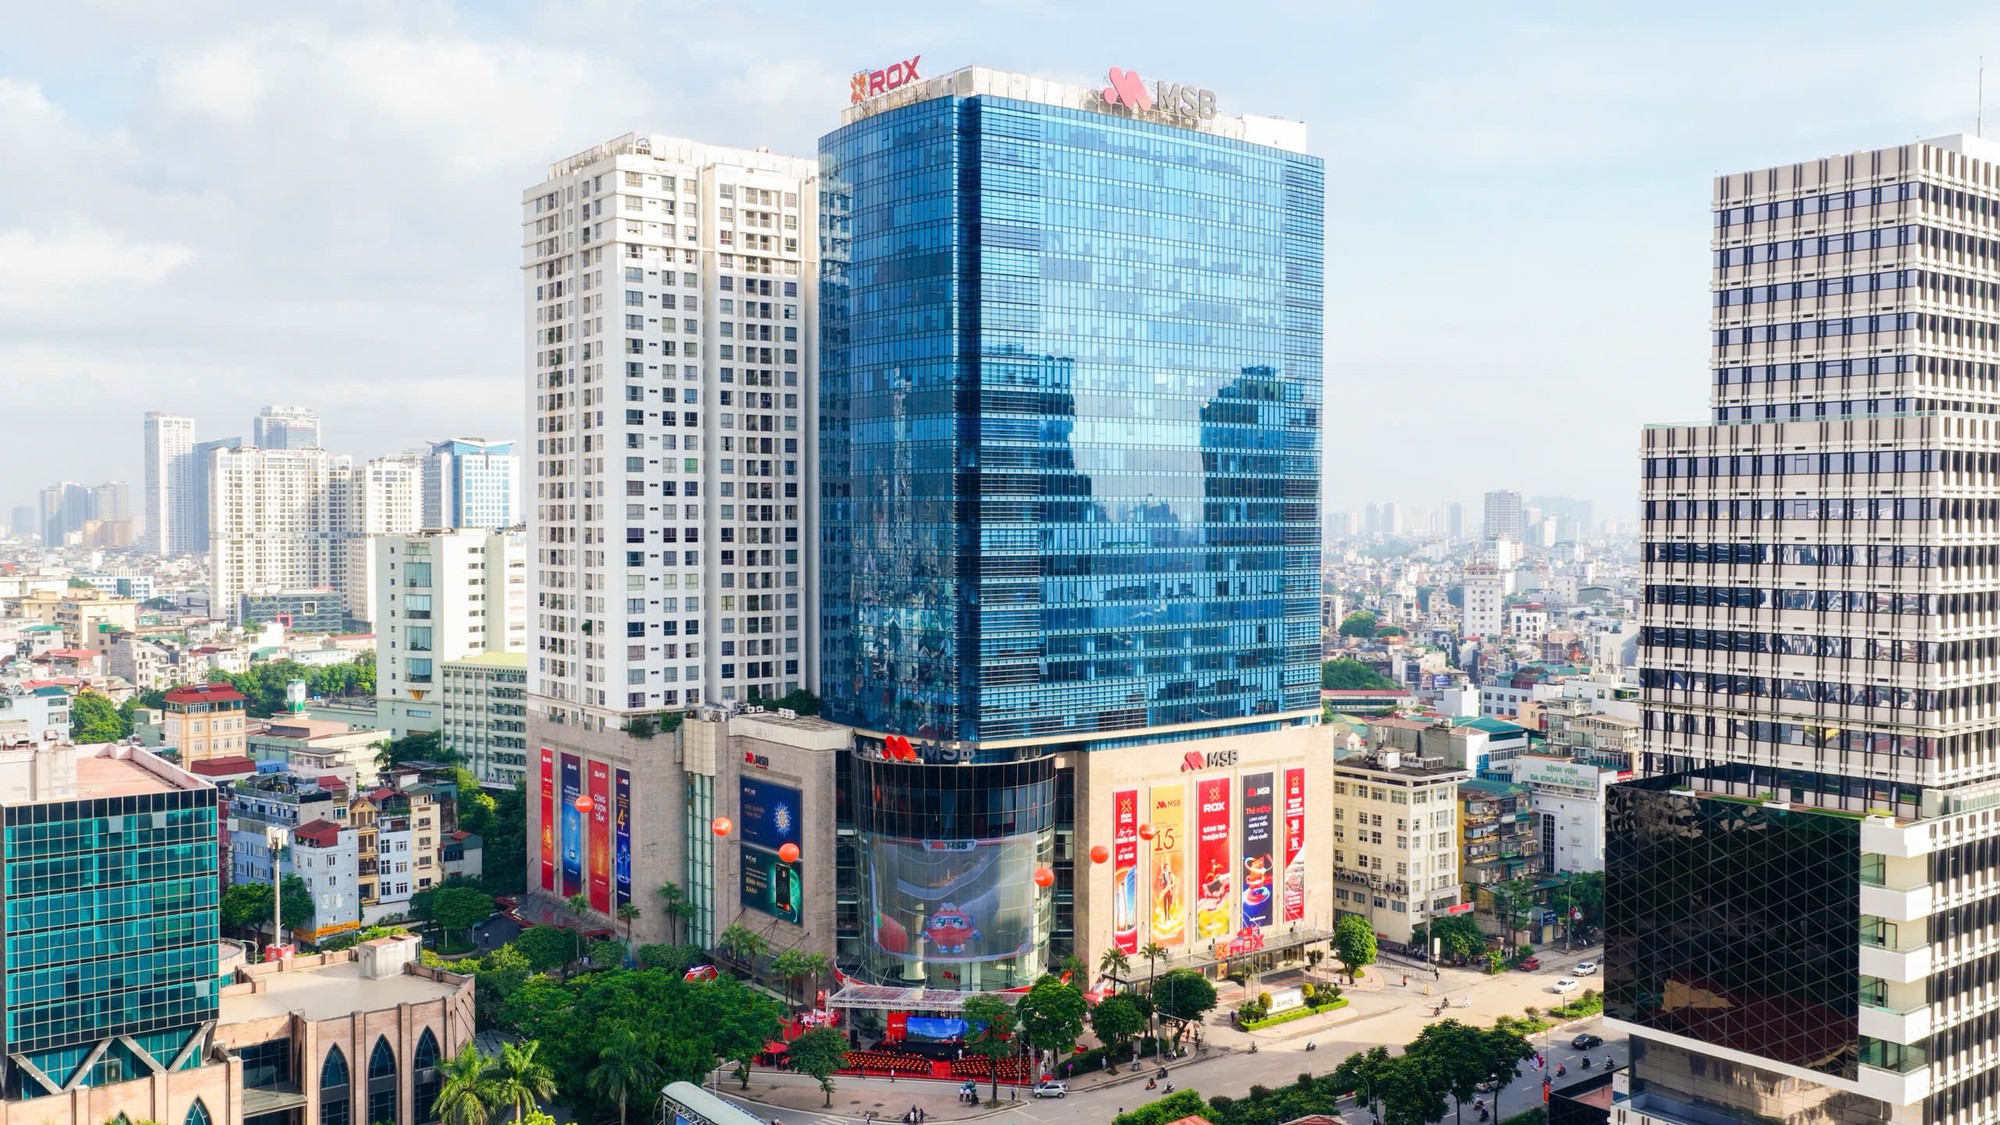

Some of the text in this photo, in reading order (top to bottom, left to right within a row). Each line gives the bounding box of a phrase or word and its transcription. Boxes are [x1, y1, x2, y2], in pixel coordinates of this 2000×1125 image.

[869, 54, 921, 96] ROX
[1157, 80, 1217, 120] MSB
[921, 740, 976, 762] MSB
[1207, 749, 1239, 768] MSB
[1540, 775, 1558, 783] KHOA
[594, 794, 606, 803] CÙNG
[1257, 787, 1270, 796] MSB
[1168, 799, 1181, 807] MSB
[1203, 802, 1225, 813] ROX
[617, 808, 625, 831] 4
[946, 841, 967, 849] MSB
[1154, 828, 1175, 851] 15
